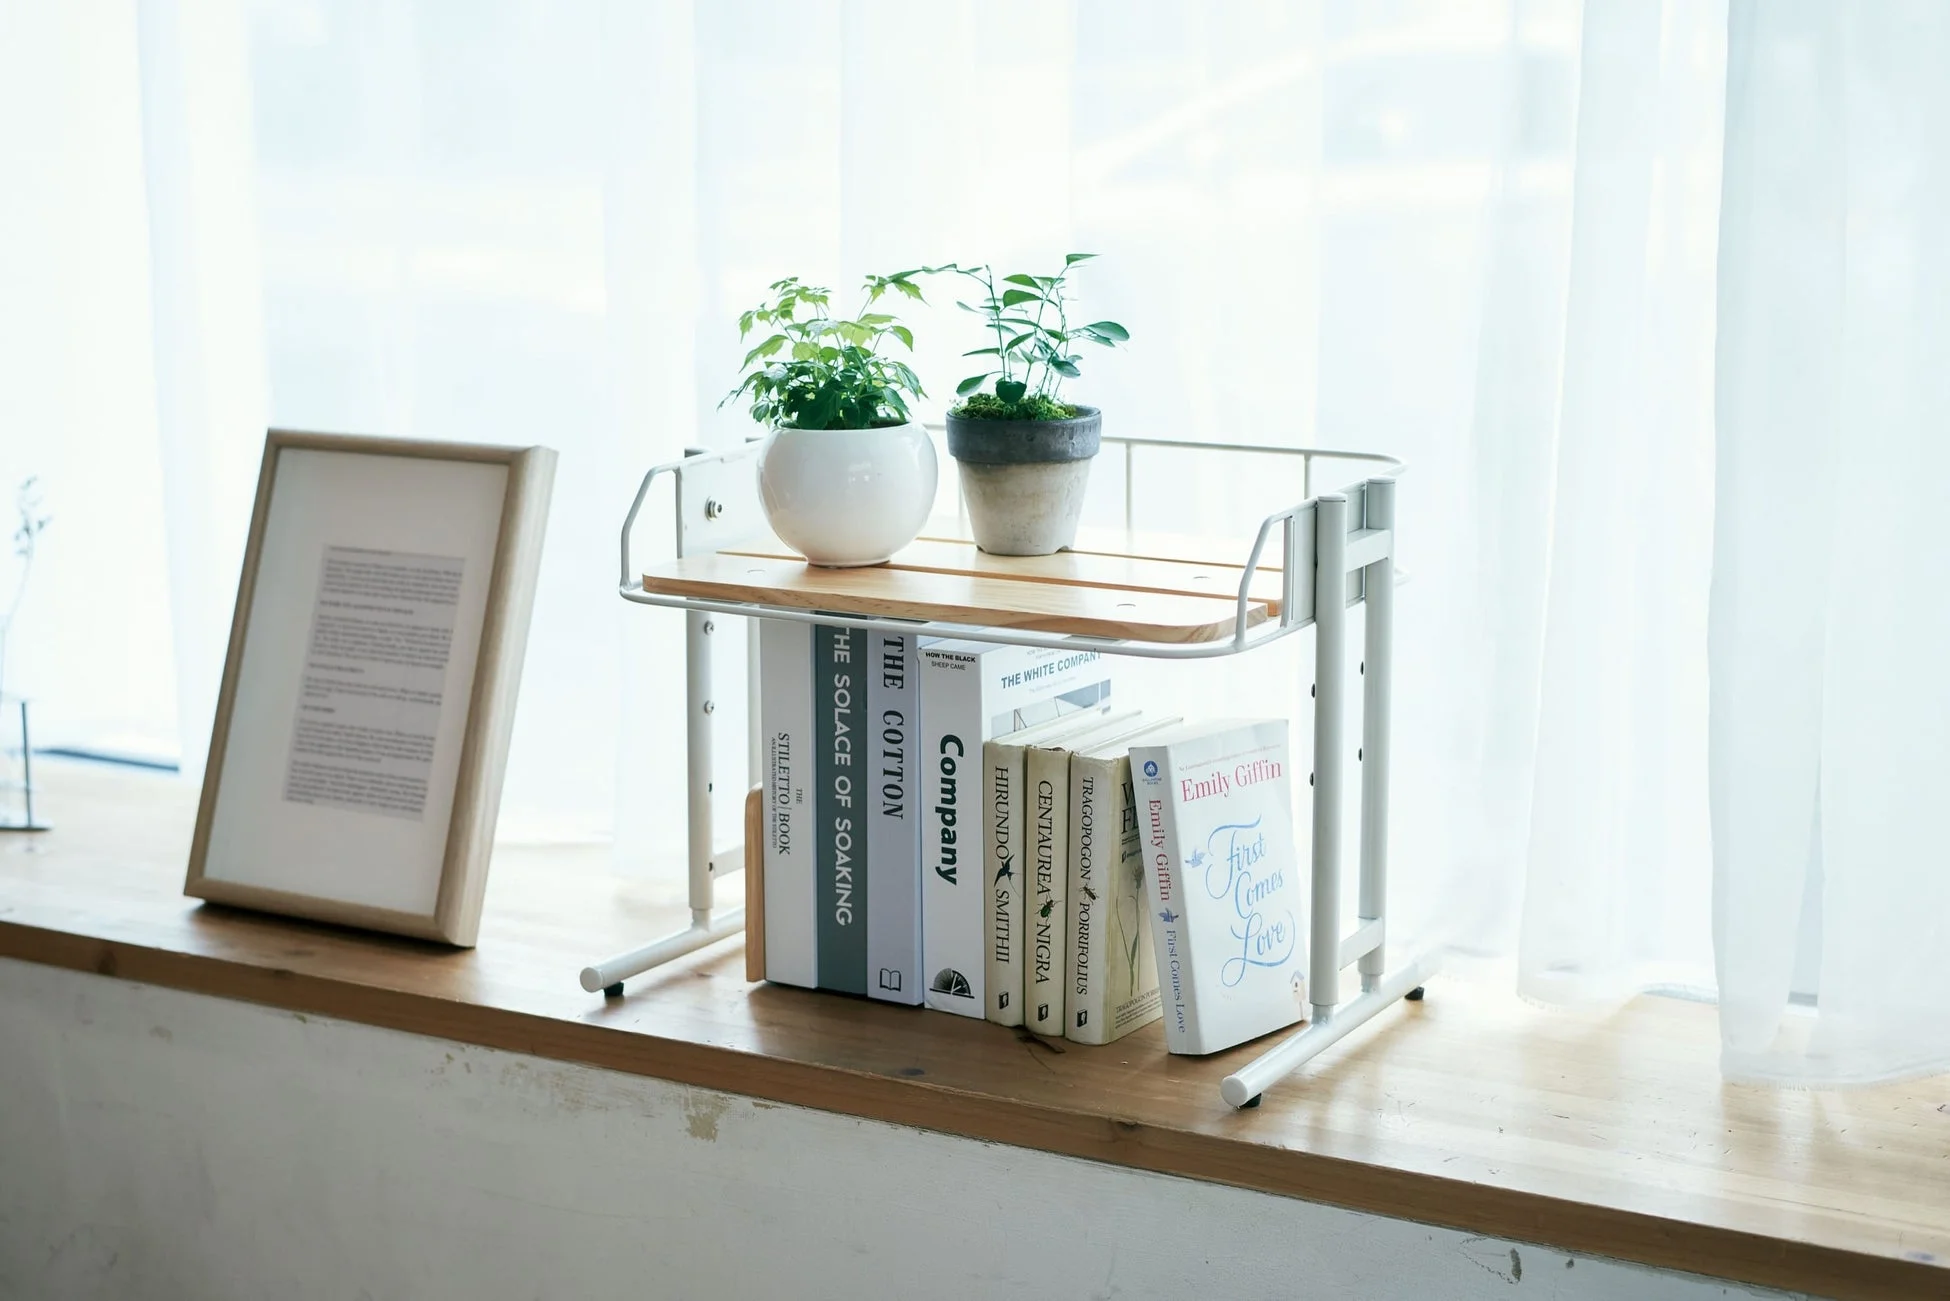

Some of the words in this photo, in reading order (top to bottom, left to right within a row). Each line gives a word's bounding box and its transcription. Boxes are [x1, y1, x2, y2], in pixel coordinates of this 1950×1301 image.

[834, 627, 850, 663] HE
[883, 635, 904, 689] THE
[925, 651, 941, 659] HOW
[941, 653, 954, 661] THE
[954, 655, 976, 663] BLACK
[931, 660, 950, 669] SHEEP
[950, 663, 966, 671] CAME
[1001, 672, 1021, 689] THE
[1023, 662, 1055, 683] WHITE
[833, 674, 852, 766] SOLACE
[778, 732, 790, 805] STILETTO
[834, 775, 852, 808] OF
[882, 709, 905, 820] COTTON
[1180, 770, 1231, 803] Emily
[1234, 759, 1282, 788] Giffin
[778, 812, 791, 856] BOOK
[934, 733, 965, 887] Company
[995, 765, 1010, 861] HIRUNDO
[1080, 776, 1094, 881] TRAGOPOGON
[1148, 799, 1166, 849] Emily
[1036, 780, 1053, 895] CENTAUREA
[1206, 813, 1265, 899] First
[835, 817, 853, 926] SOAKING
[1155, 852, 1172, 902] Giffin
[1234, 867, 1284, 919] Comes
[995, 889, 1010, 964] SMITHII
[1035, 921, 1052, 985] NIGRA
[1076, 901, 1091, 996] PORRIFOLIUS
[1166, 929, 1179, 957] First
[1221, 909, 1295, 988] Love
[1170, 959, 1185, 1001] Comes
[1175, 1003, 1186, 1033] Love
